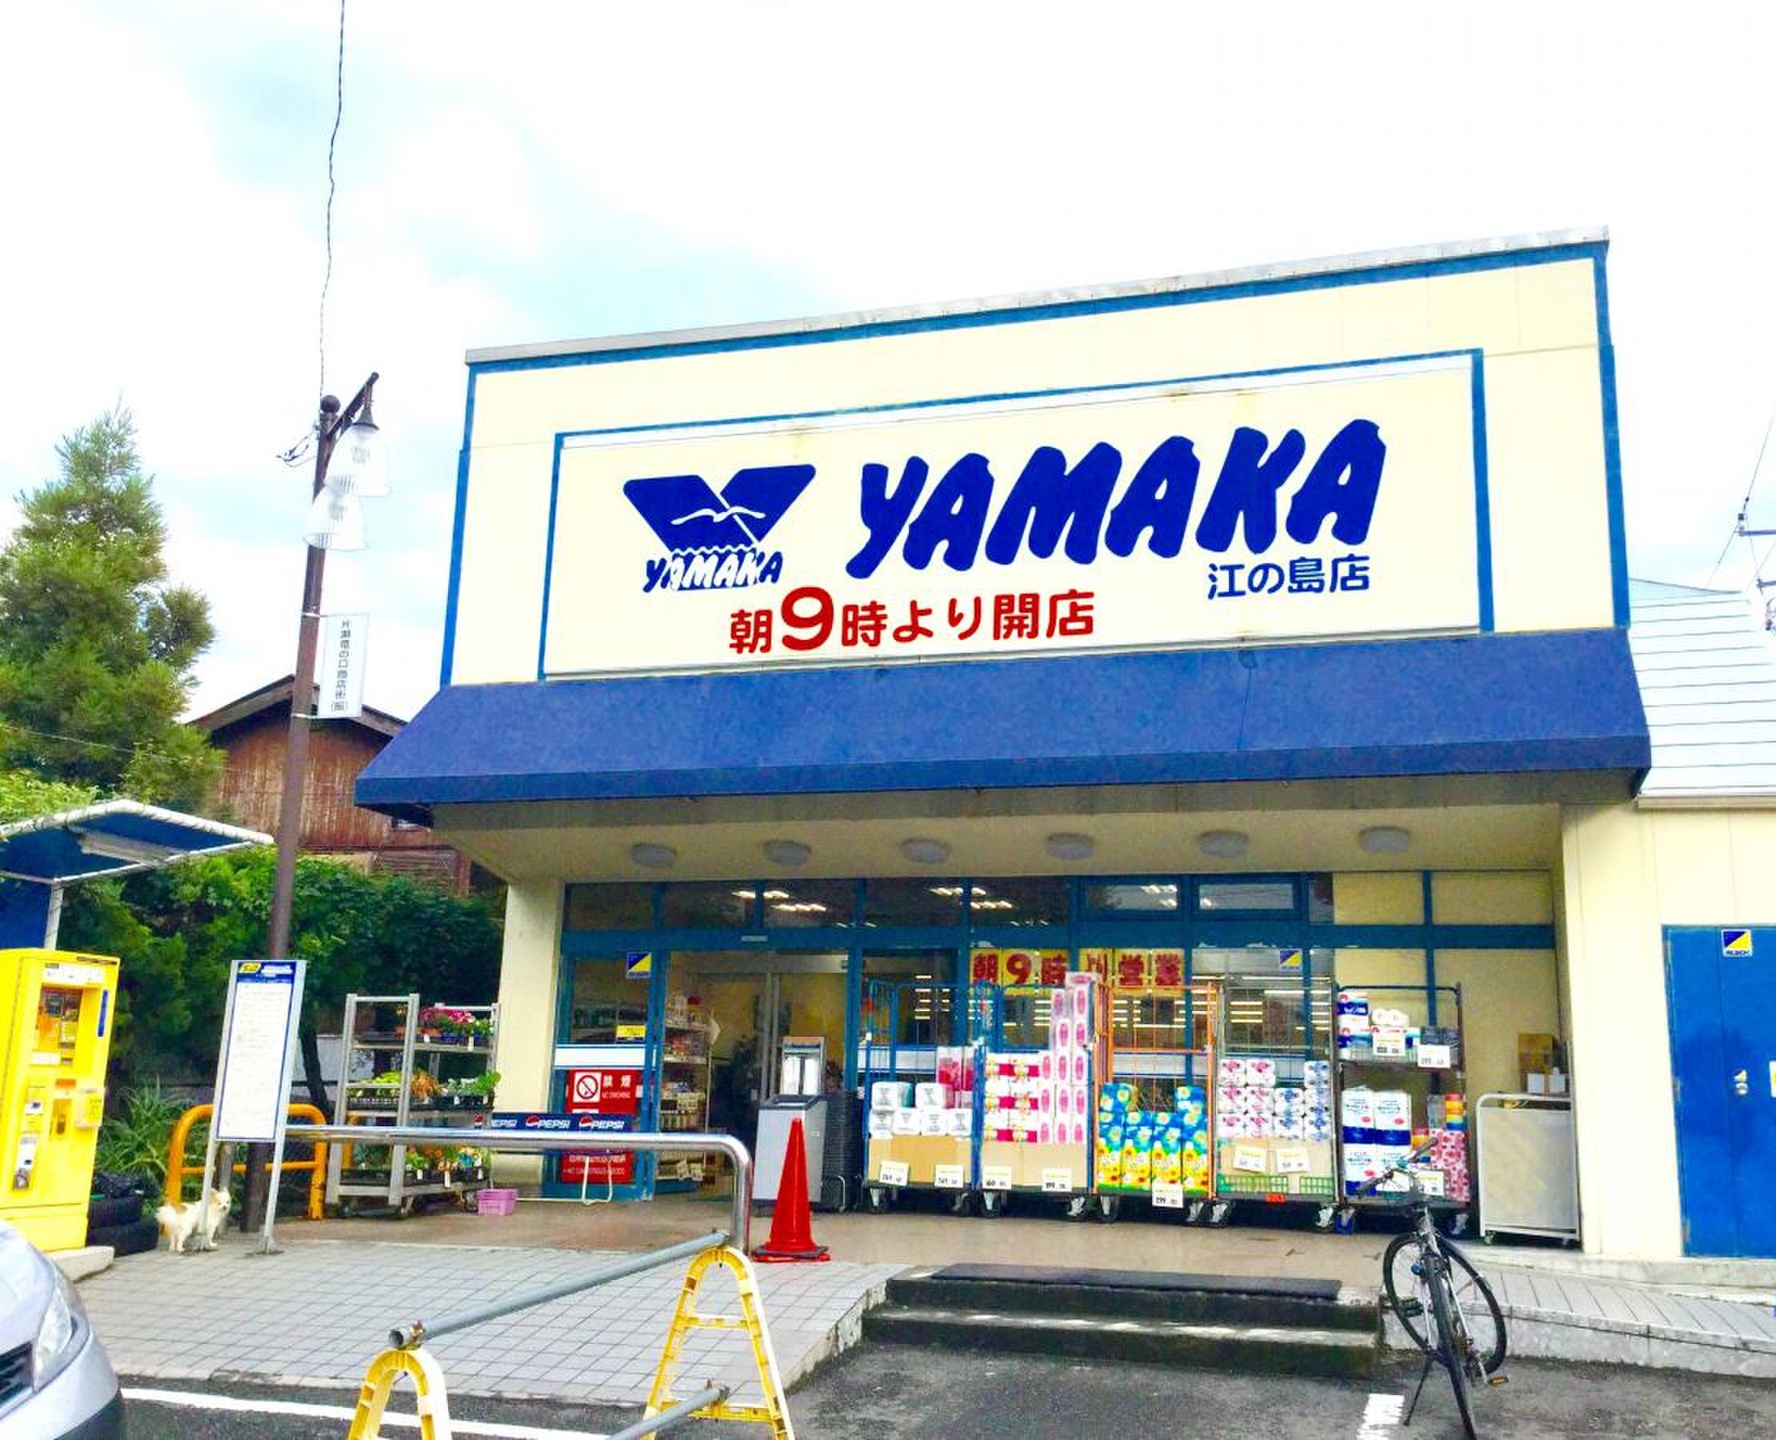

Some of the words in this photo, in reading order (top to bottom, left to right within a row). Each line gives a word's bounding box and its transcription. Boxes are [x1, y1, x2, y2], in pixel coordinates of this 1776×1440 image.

[846, 418, 1387, 581] YAMAKA
[643, 548, 784, 593] YAMAKA
[1207, 556, 1371, 600] 江の島店
[729, 586, 1095, 655] 朝9時より開店
[537, 1119, 571, 1129] PEPSI
[591, 1120, 625, 1130] PEPSI
